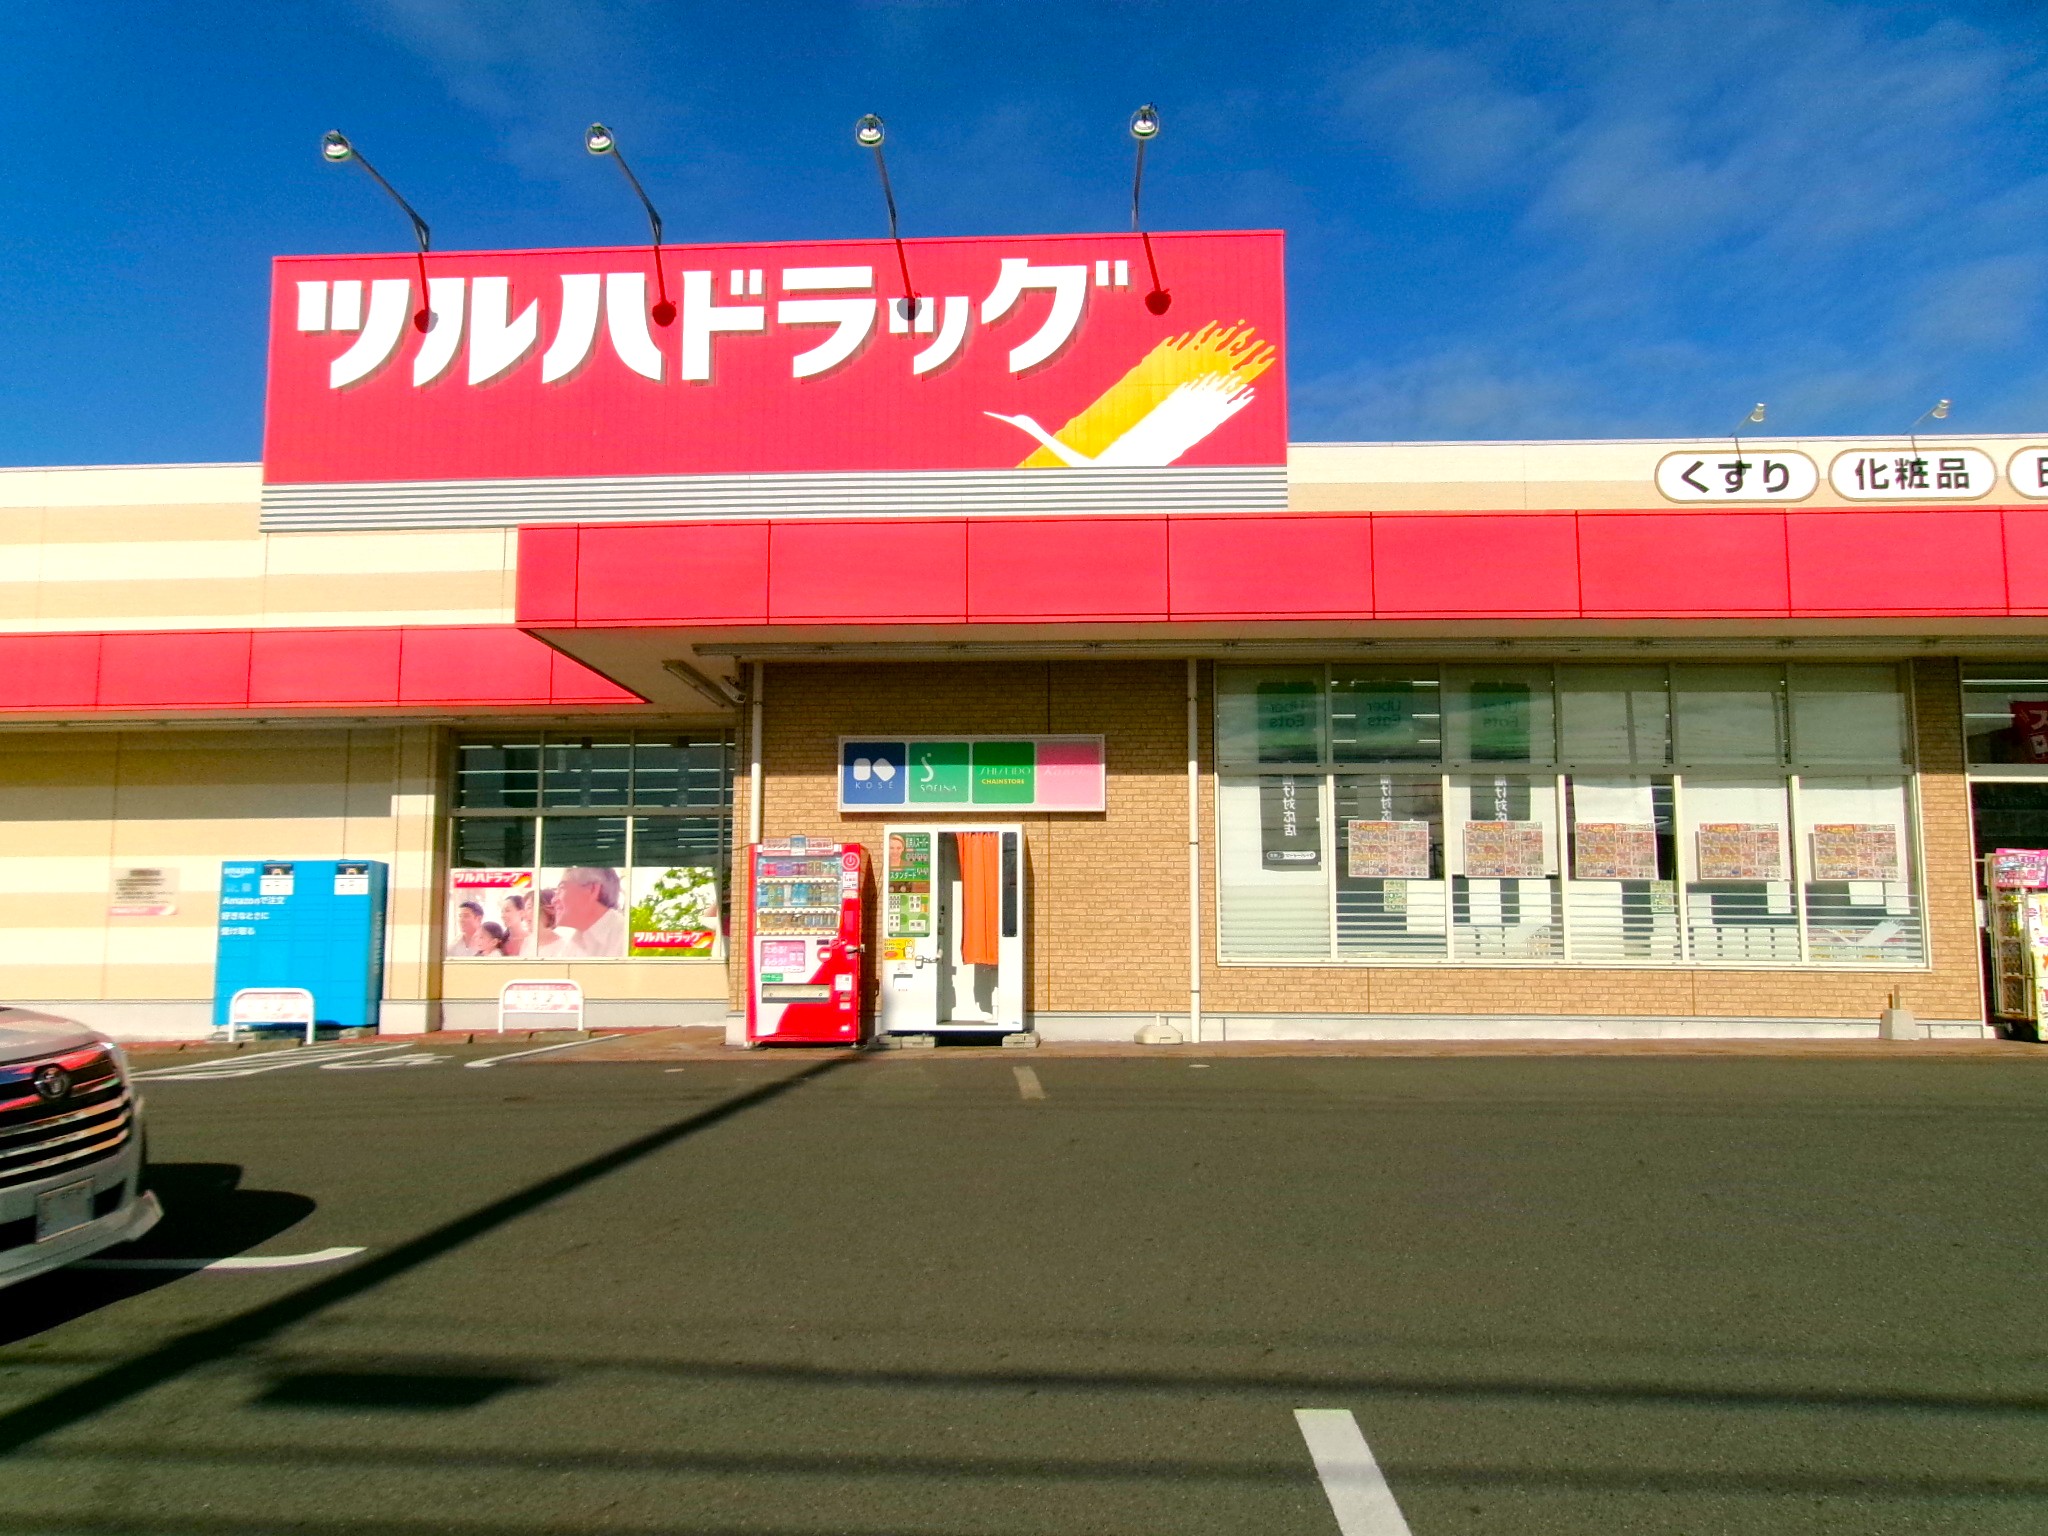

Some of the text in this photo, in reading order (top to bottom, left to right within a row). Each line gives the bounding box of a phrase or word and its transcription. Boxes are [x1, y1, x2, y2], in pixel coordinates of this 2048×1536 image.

[296, 257, 1130, 389] ツルハドラッグ
[1681, 460, 1789, 494] くすり
[1855, 457, 1970, 491] 化粧品
[920, 784, 958, 792] SOFINA
